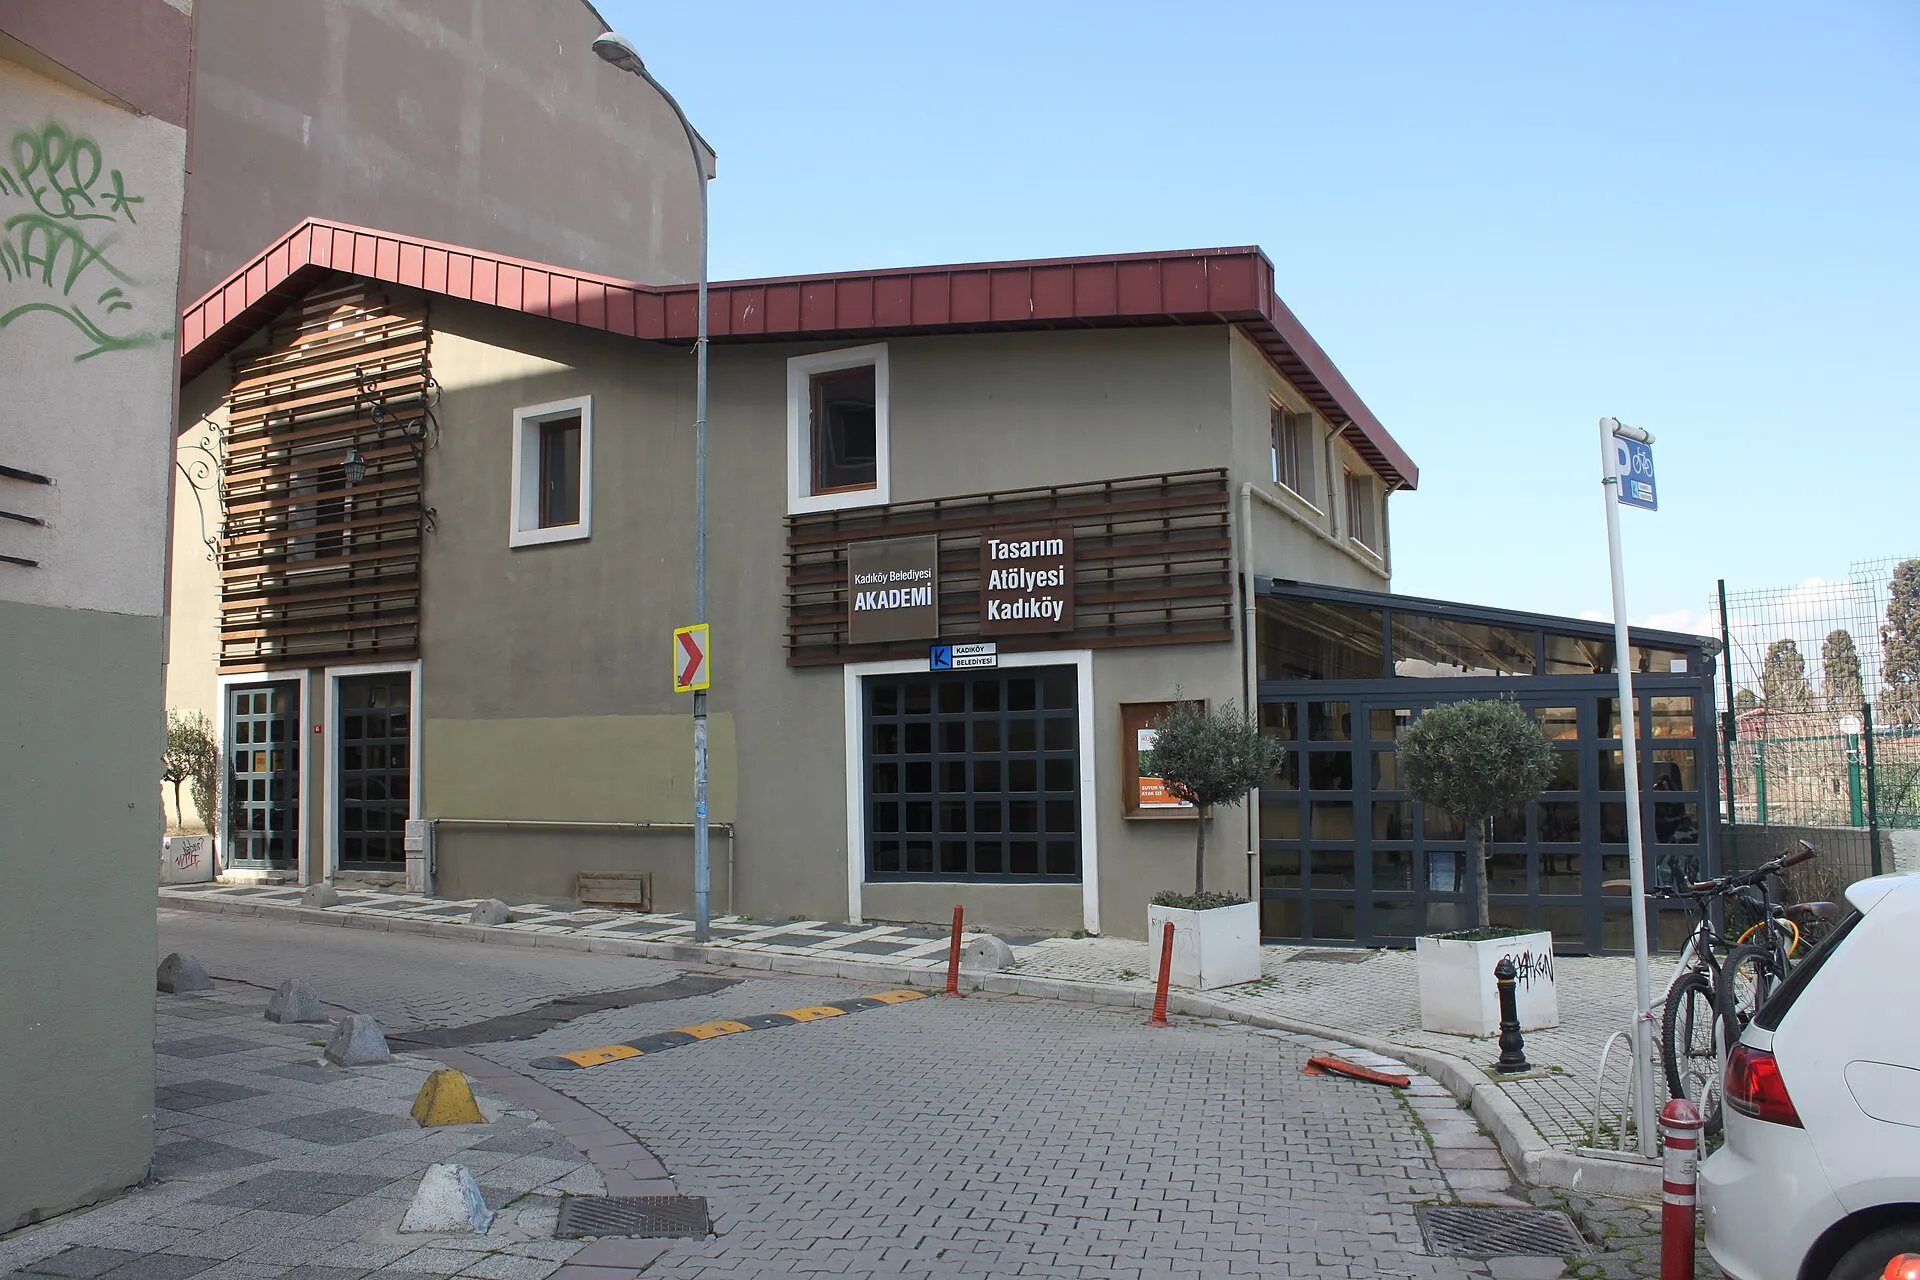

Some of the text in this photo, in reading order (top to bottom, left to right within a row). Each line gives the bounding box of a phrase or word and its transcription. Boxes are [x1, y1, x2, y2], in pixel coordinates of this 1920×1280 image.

[1614, 438, 1631, 497] P
[988, 538, 1064, 560] Tasarım
[854, 567, 932, 585] Kadıköy Belediyesi
[988, 565, 1064, 593] Atölyesi
[854, 582, 932, 611] AKADEMİ
[988, 596, 1064, 622] Kadıköy
[934, 647, 950, 666] K
[956, 657, 993, 666] BELEDİYESİ
